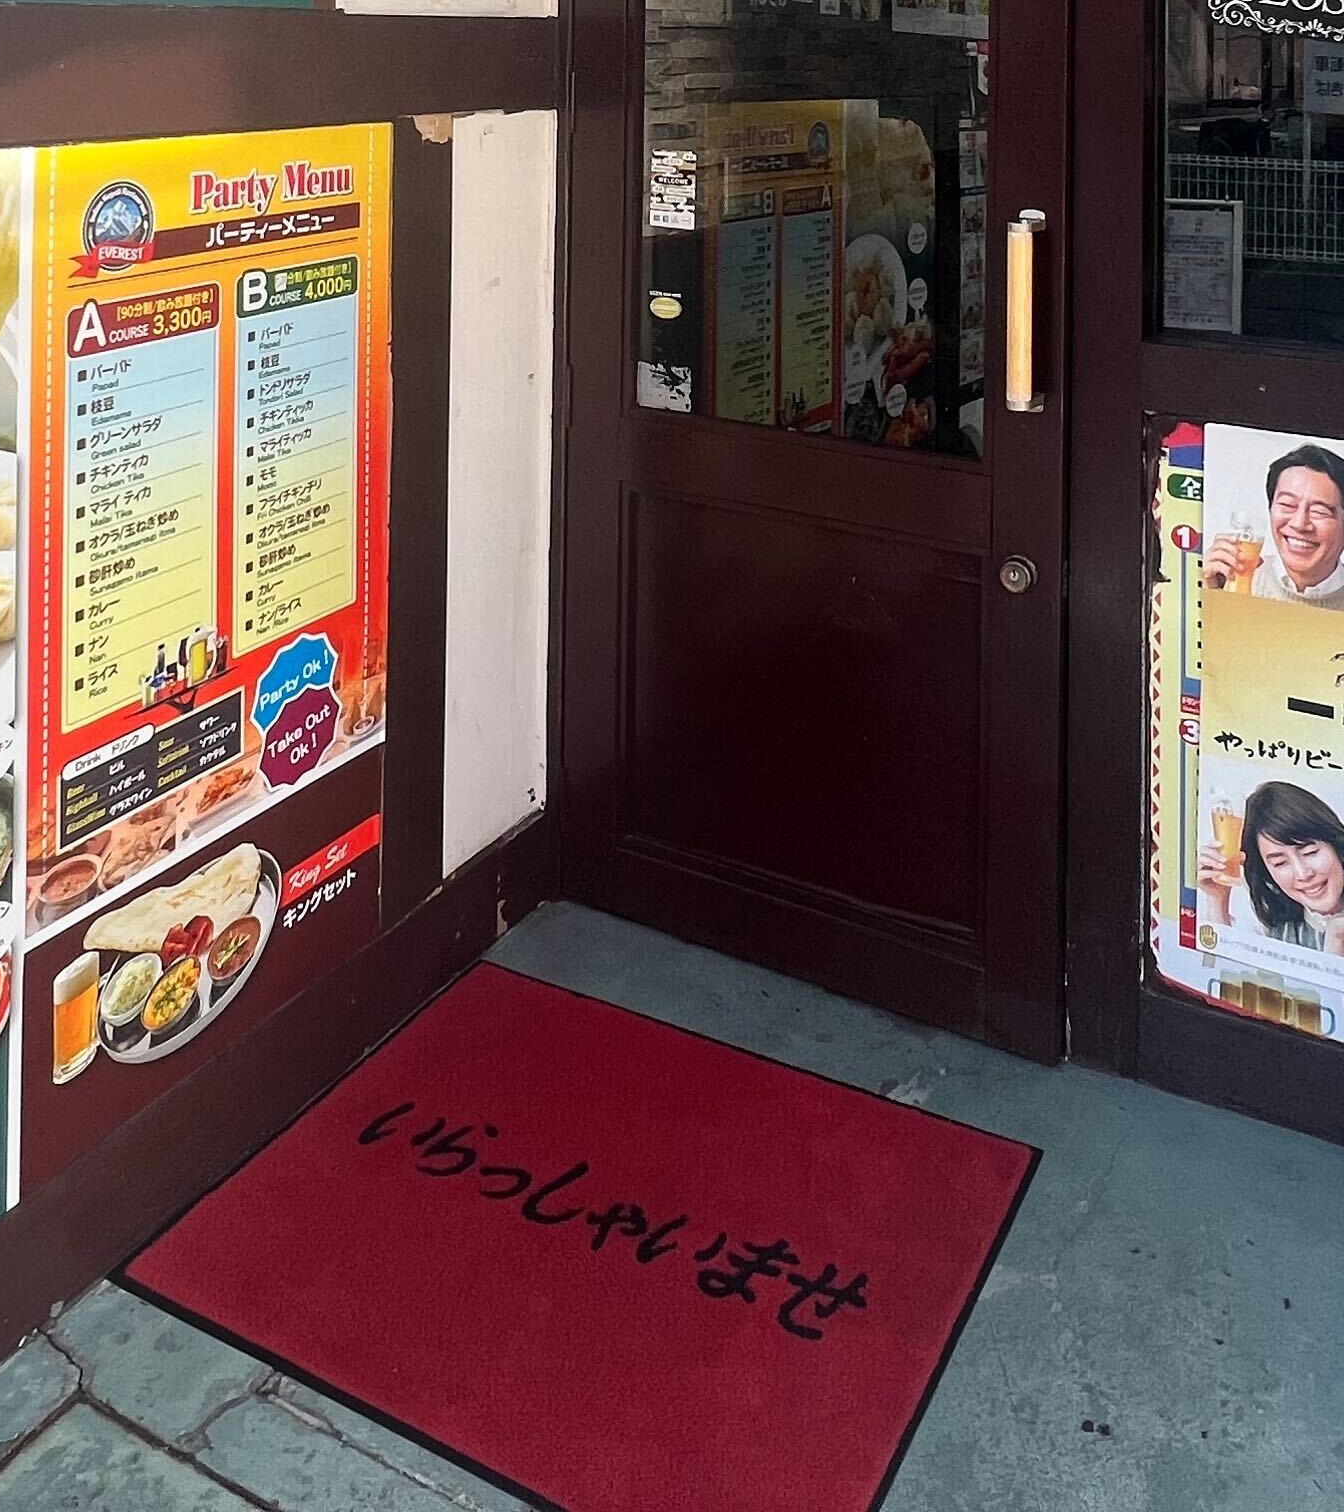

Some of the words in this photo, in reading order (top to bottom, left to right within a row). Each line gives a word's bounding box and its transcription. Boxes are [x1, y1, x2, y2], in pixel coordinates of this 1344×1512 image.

[191, 171, 277, 214] Party
[283, 162, 353, 199] Menu
[207, 214, 335, 248] パーティーメニュー
[98, 247, 145, 260] EVEREST
[243, 271, 268, 311] B
[269, 290, 302, 307] COURSE
[73, 301, 107, 353] A
[109, 324, 150, 344] COURSE
[152, 307, 212, 336] 3,300円
[90, 416, 162, 449] グリーンサラダ
[88, 599, 121, 619] カレー
[88, 635, 109, 652] ナン
[88, 664, 119, 686] ライス
[260, 675, 299, 712] Party
[267, 727, 303, 758] Take
[305, 704, 331, 731] Out
[283, 868, 356, 928] キングセット
[357, 1101, 869, 1343] いらっしゃいませ
